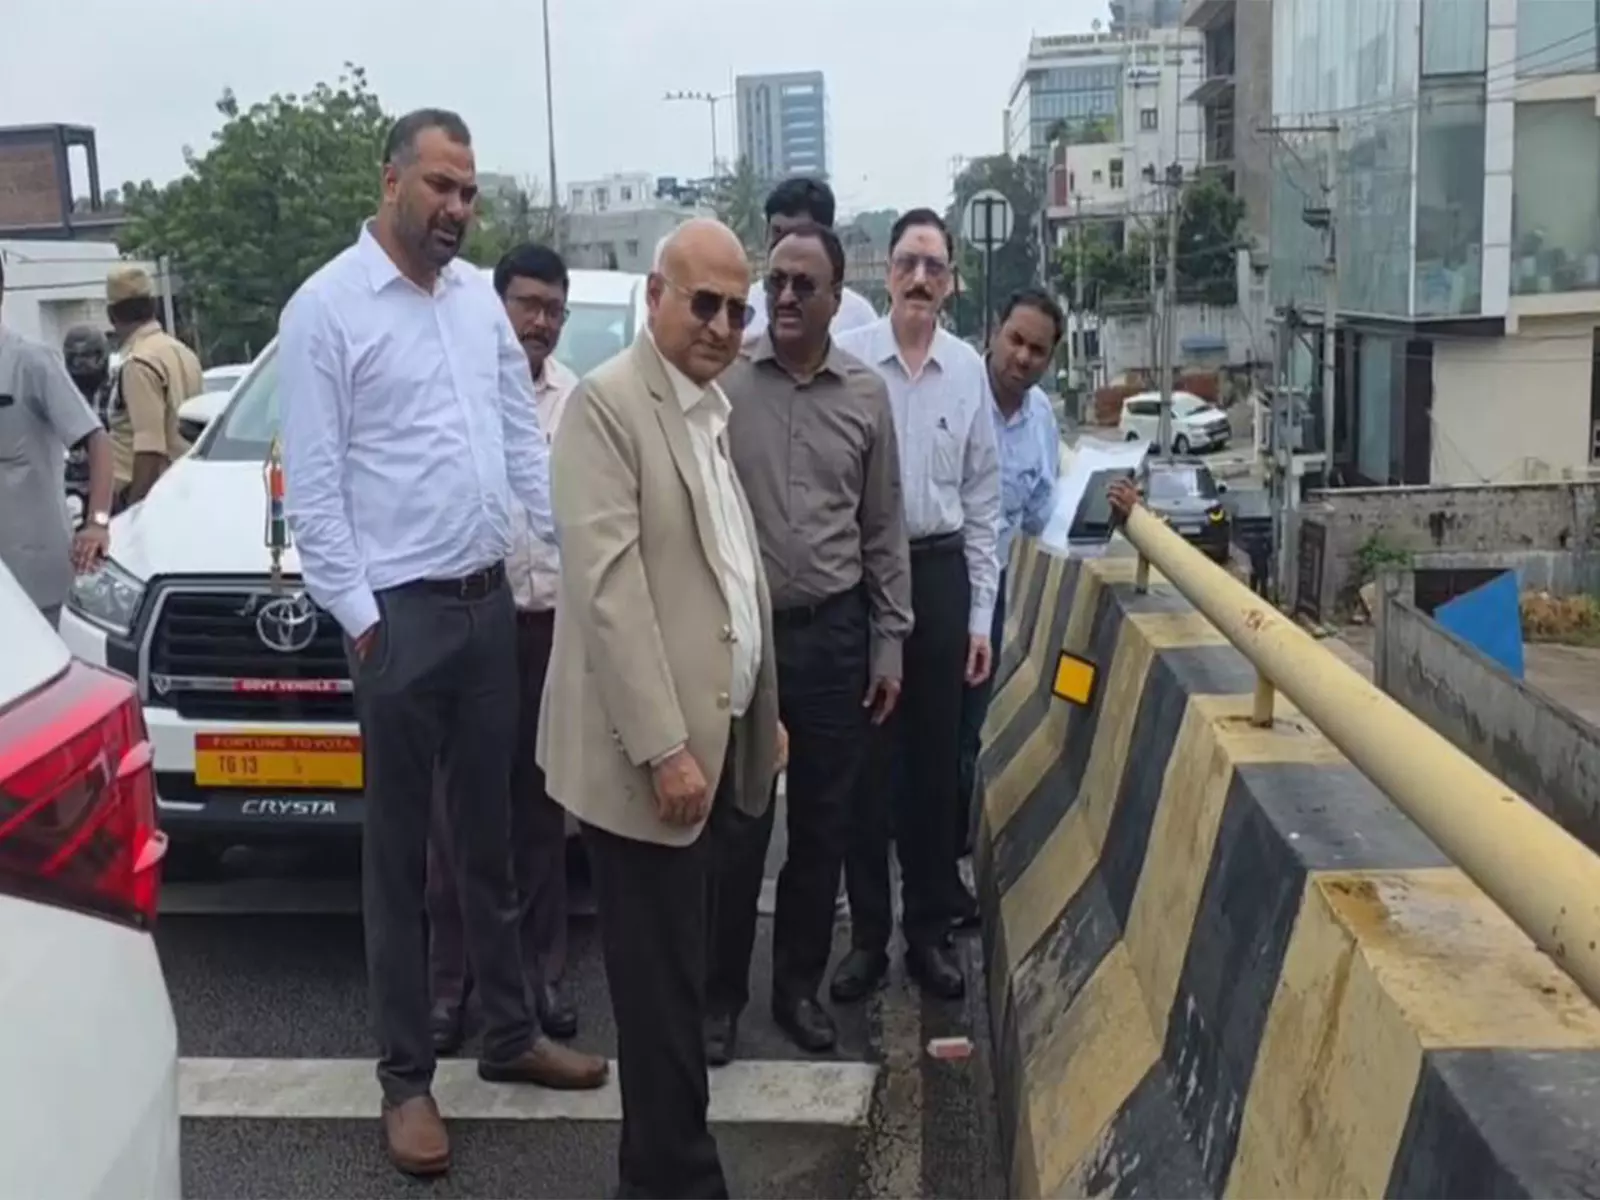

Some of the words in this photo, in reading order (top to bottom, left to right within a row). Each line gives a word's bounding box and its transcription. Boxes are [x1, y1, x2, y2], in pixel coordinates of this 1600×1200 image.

[213, 736, 286, 748] FORTUNE
[292, 737, 354, 749] TOYOTA
[242, 800, 336, 815] CRYSTA
